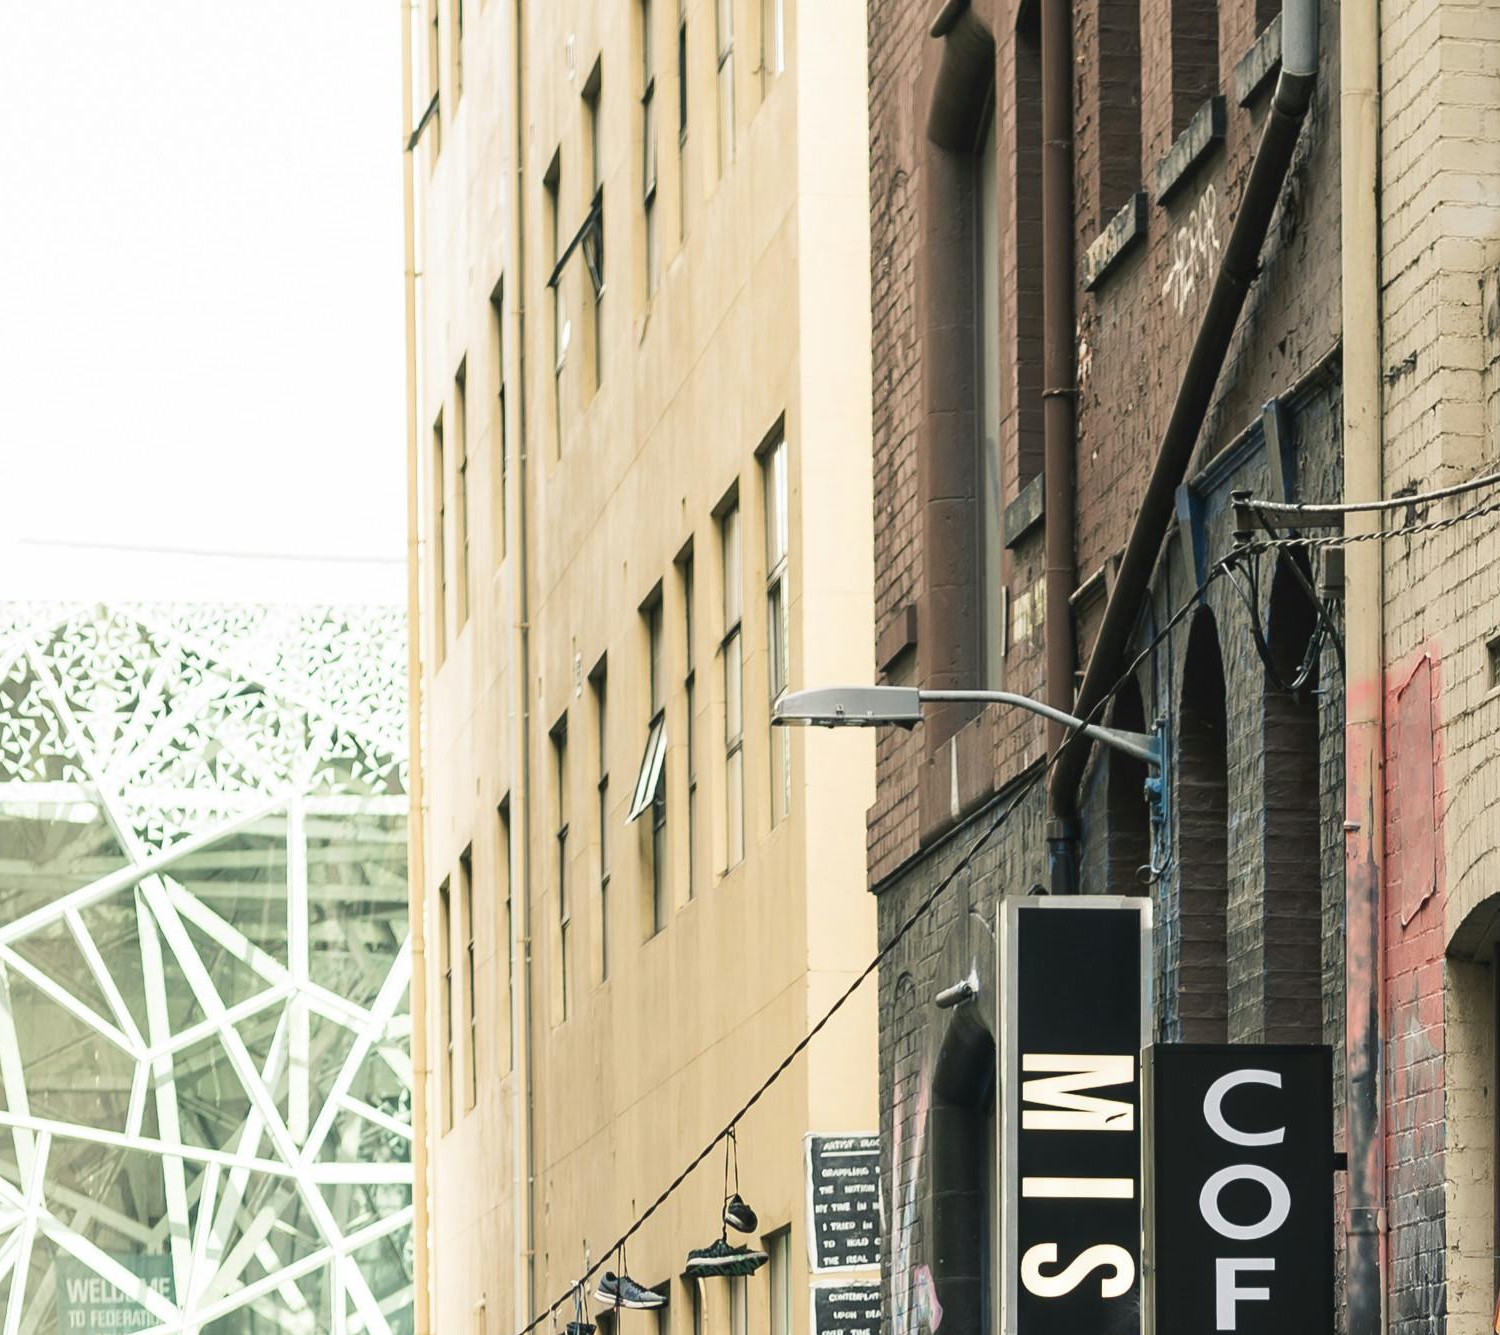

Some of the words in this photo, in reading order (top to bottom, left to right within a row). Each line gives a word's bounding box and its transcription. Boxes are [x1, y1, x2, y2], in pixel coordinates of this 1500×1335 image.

[822, 1167, 869, 1178] GRAPPLING
[819, 1185, 834, 1195] THE
[823, 1240, 835, 1248] TO
[823, 1256, 839, 1266] THE
[833, 1311, 857, 1319] UPON
